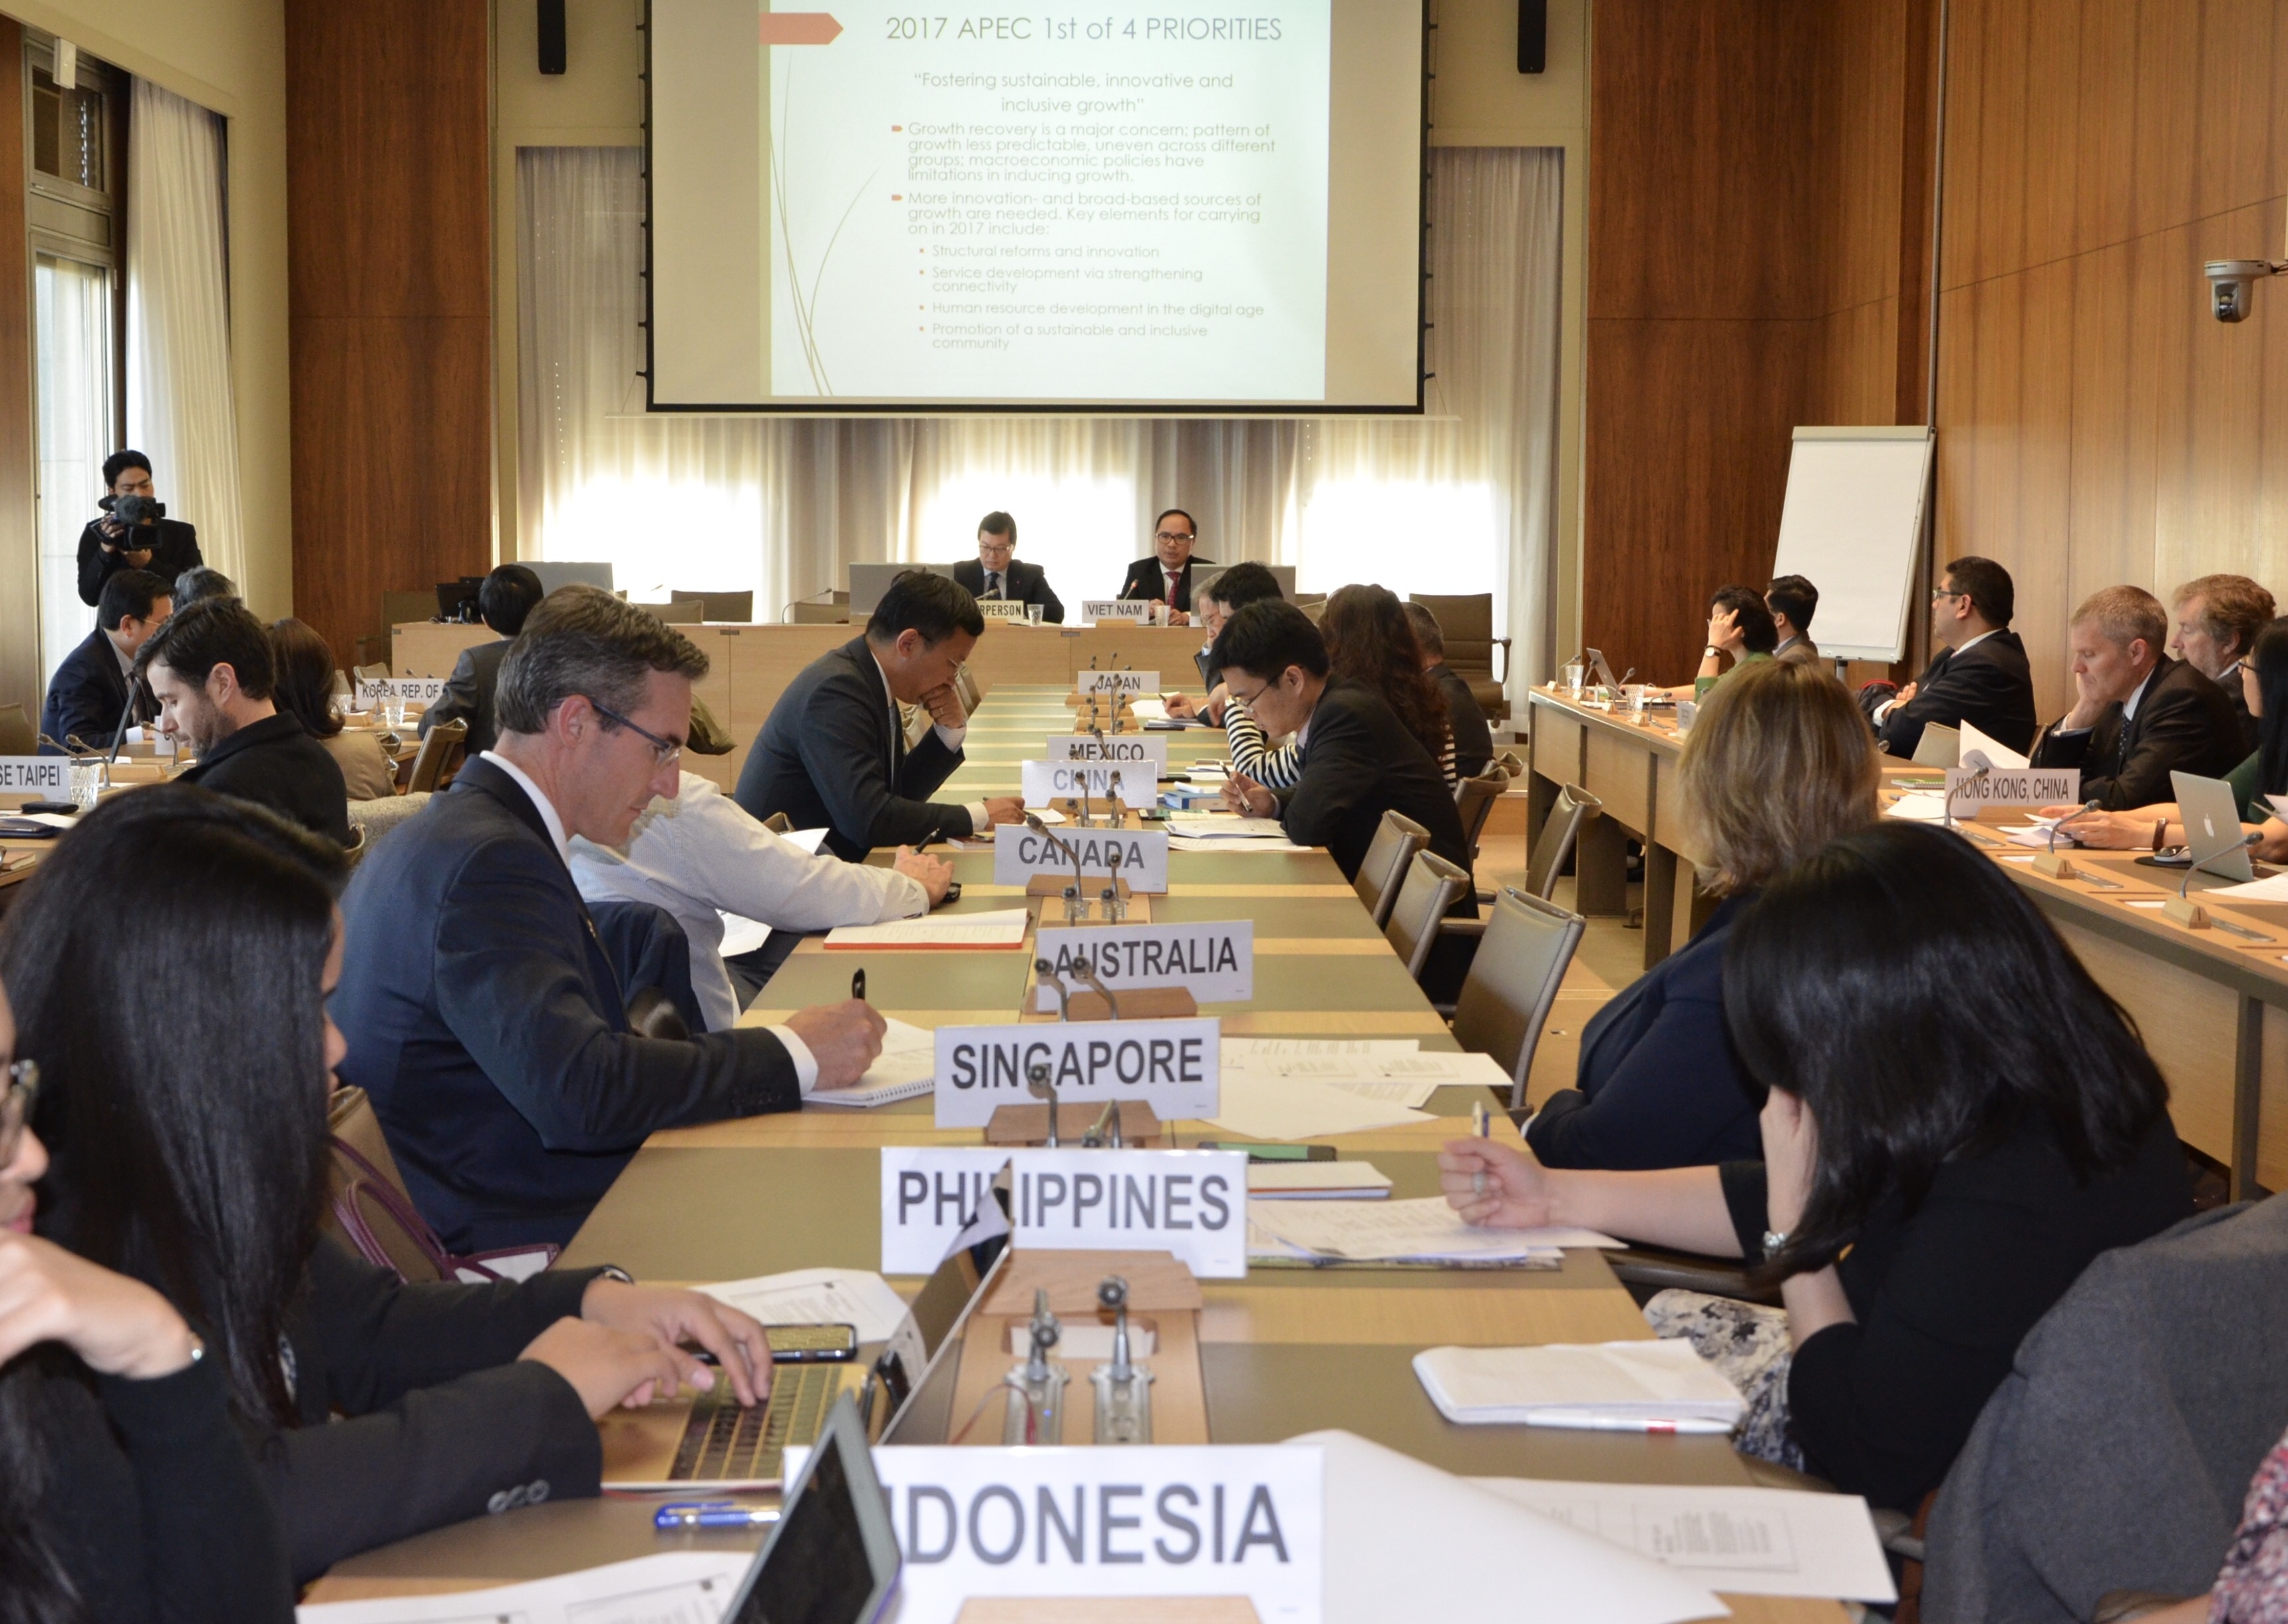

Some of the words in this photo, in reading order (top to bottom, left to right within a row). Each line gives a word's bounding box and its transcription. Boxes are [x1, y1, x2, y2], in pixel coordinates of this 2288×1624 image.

[886, 17, 947, 39] 2017
[957, 17, 1031, 39] APEC
[1045, 17, 1076, 39] 1st
[1086, 17, 1112, 39] of
[1122, 19, 1136, 39] 4
[1147, 18, 1281, 41] PRIORITIES
[1106, 73, 1194, 88] innovative
[1199, 74, 1233, 88] and
[1002, 97, 1071, 112] inclusive
[908, 122, 965, 135] Growth
[969, 126, 1037, 138] recovery
[1042, 122, 1051, 136] is
[1056, 126, 1065, 136] a
[1071, 123, 1114, 138] major
[1119, 126, 1188, 138] concern;
[1194, 123, 1249, 139] pattern
[1255, 124, 1270, 136] of
[908, 138, 961, 153] growth
[967, 138, 991, 151] less
[997, 138, 1089, 154] predictable,
[1096, 141, 1153, 152] uneven
[1158, 142, 1206, 152] across
[1212, 139, 1275, 152] different
[908, 156, 963, 168] groups;
[969, 153, 1097, 166] macroeconomic
[1104, 153, 1160, 169] policies
[1166, 154, 1204, 167] have
[908, 168, 983, 182] limitations
[987, 168, 999, 182] in
[1005, 168, 1070, 185] inducing
[1076, 168, 1133, 185] growth.
[909, 192, 947, 204] More
[953, 192, 1037, 204] innovation-
[1043, 193, 1073, 205] and
[1078, 193, 1179, 205] broad-based
[1184, 196, 1241, 206] sources
[1246, 194, 1261, 206] of
[908, 207, 961, 222] growth
[967, 210, 991, 220] are
[997, 208, 1061, 220] needed.
[1067, 208, 1094, 223] Key
[1099, 208, 1168, 220] elements
[1174, 208, 1193, 220] for
[1198, 208, 1260, 223] carrying
[908, 225, 927, 235] on
[933, 222, 944, 235] in
[950, 222, 983, 235] 2017
[989, 222, 1049, 235] include:
[933, 245, 996, 257] Structural
[1001, 245, 1051, 257] reforms
[1055, 246, 1082, 257] and
[1087, 246, 1159, 257] innovation
[933, 267, 981, 279] Service
[987, 267, 1079, 281] development
[1084, 267, 1104, 279] via
[1108, 268, 1203, 282] strengthening
[933, 280, 1017, 294] connectivity
[933, 303, 982, 313] Human
[986, 305, 1045, 313] resource
[1050, 303, 1143, 315] development
[1148, 303, 1158, 314] in
[1164, 303, 1185, 315] the
[1190, 303, 1231, 317] digital
[1235, 306, 1264, 318] age
[933, 323, 1002, 335] Promotion
[1006, 323, 1019, 335] of
[1024, 326, 1033, 335] a
[1037, 324, 1114, 335] sustainable
[1118, 324, 1146, 336] and
[1150, 324, 1208, 336] inclusive
[932, 337, 1009, 351] community
[1088, 605, 1113, 616] VIET
[1117, 605, 1142, 616] NAM
[402, 684, 423, 698] REP.
[426, 685, 438, 698] OF
[1096, 677, 1140, 690] JAAN
[17, 765, 60, 786] TAIPEI
[1956, 777, 1989, 799] HONG
[1993, 778, 2029, 803] KONG,
[2033, 778, 2069, 800] CHINA
[1019, 836, 1145, 869] CANADA
[898, 1171, 1230, 1231] PHIIPPINES
